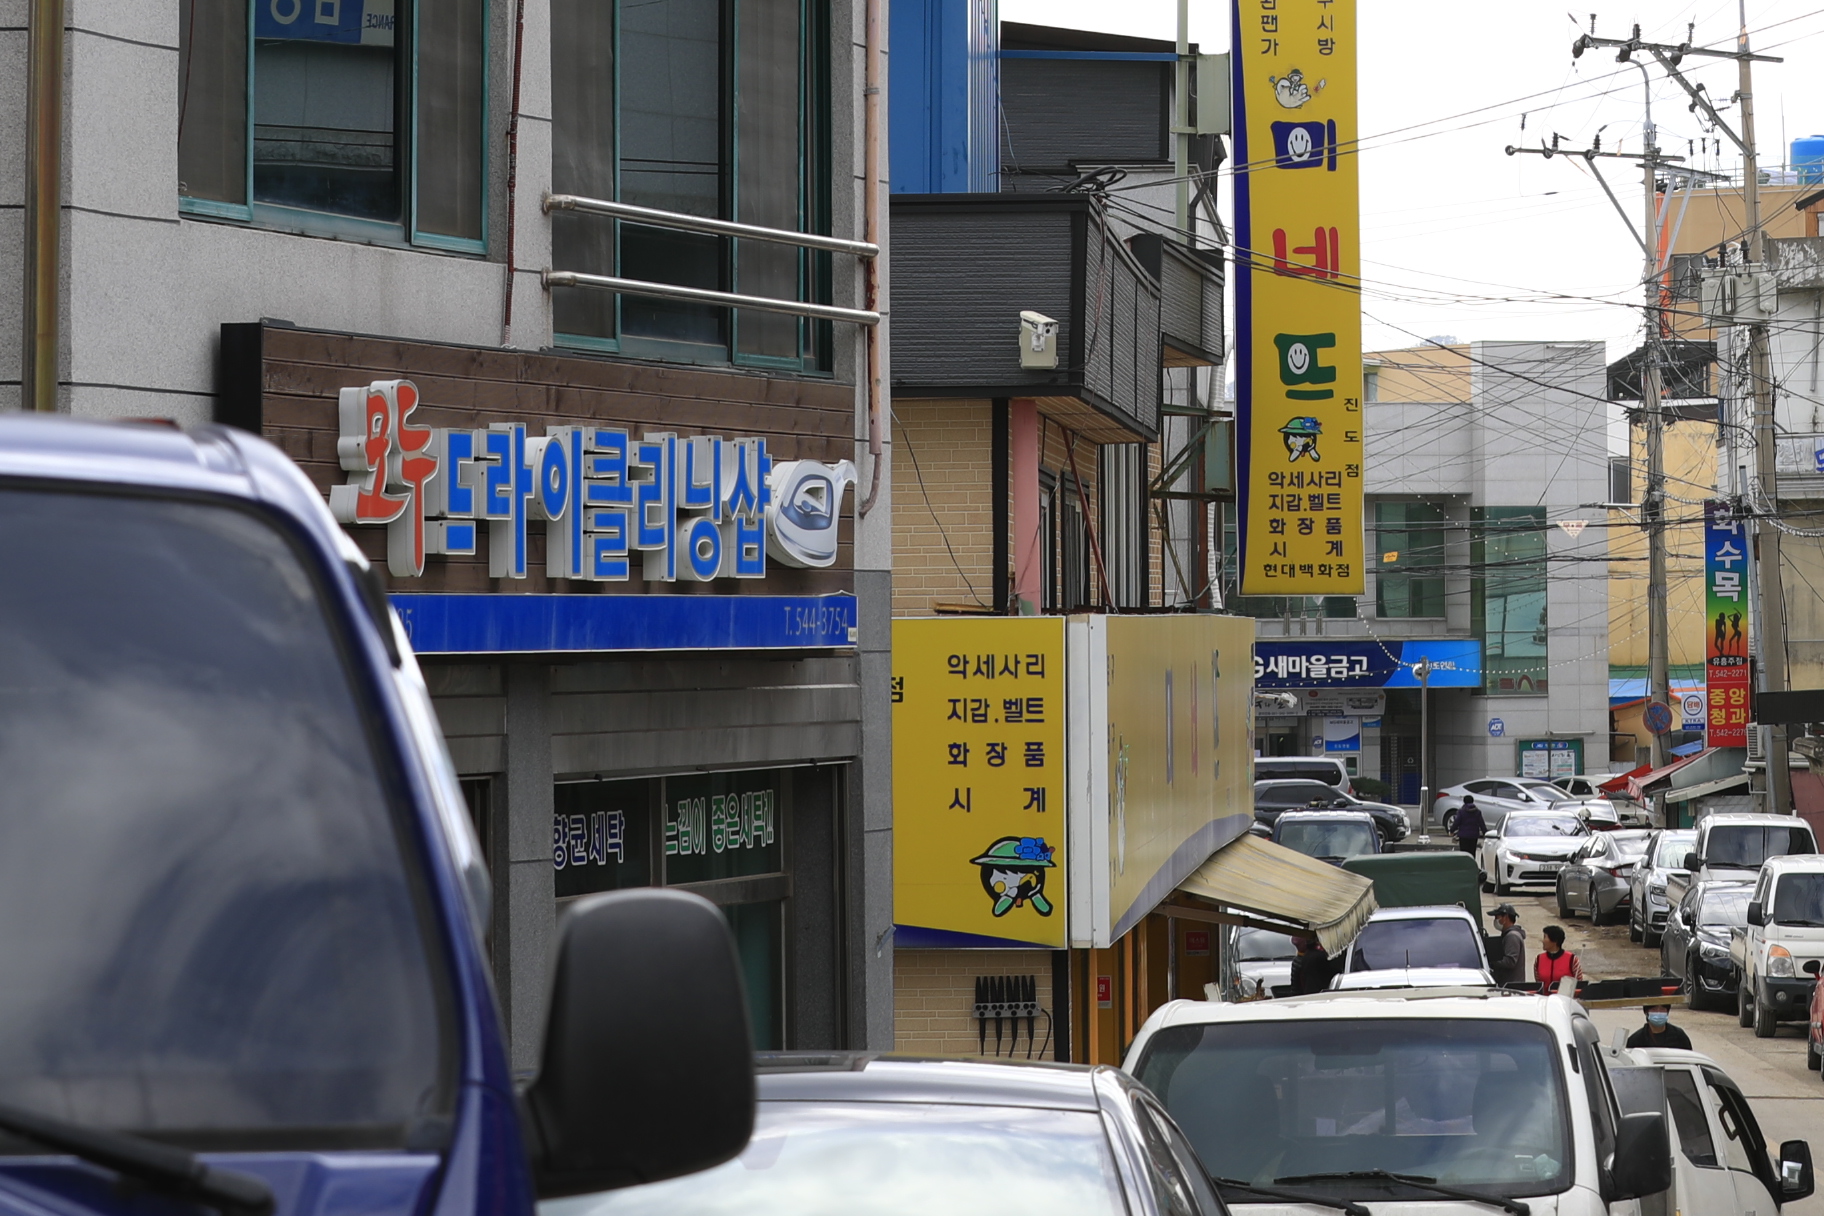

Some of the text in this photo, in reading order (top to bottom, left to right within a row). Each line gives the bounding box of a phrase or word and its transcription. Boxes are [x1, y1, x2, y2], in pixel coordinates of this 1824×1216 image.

[1268, 471, 1342, 489] 악세사리
[1712, 508, 1743, 602] 화수목
[1263, 564, 1350, 578] 현대백화점
[784, 606, 848, 635] T.544-3754
[947, 653, 1046, 680] 악세사리
[1713, 657, 1743, 665] 유흥주점
[1709, 669, 1747, 678] T.542-2271
[1709, 688, 1746, 706] 중앙
[1709, 708, 1746, 726] 청과
